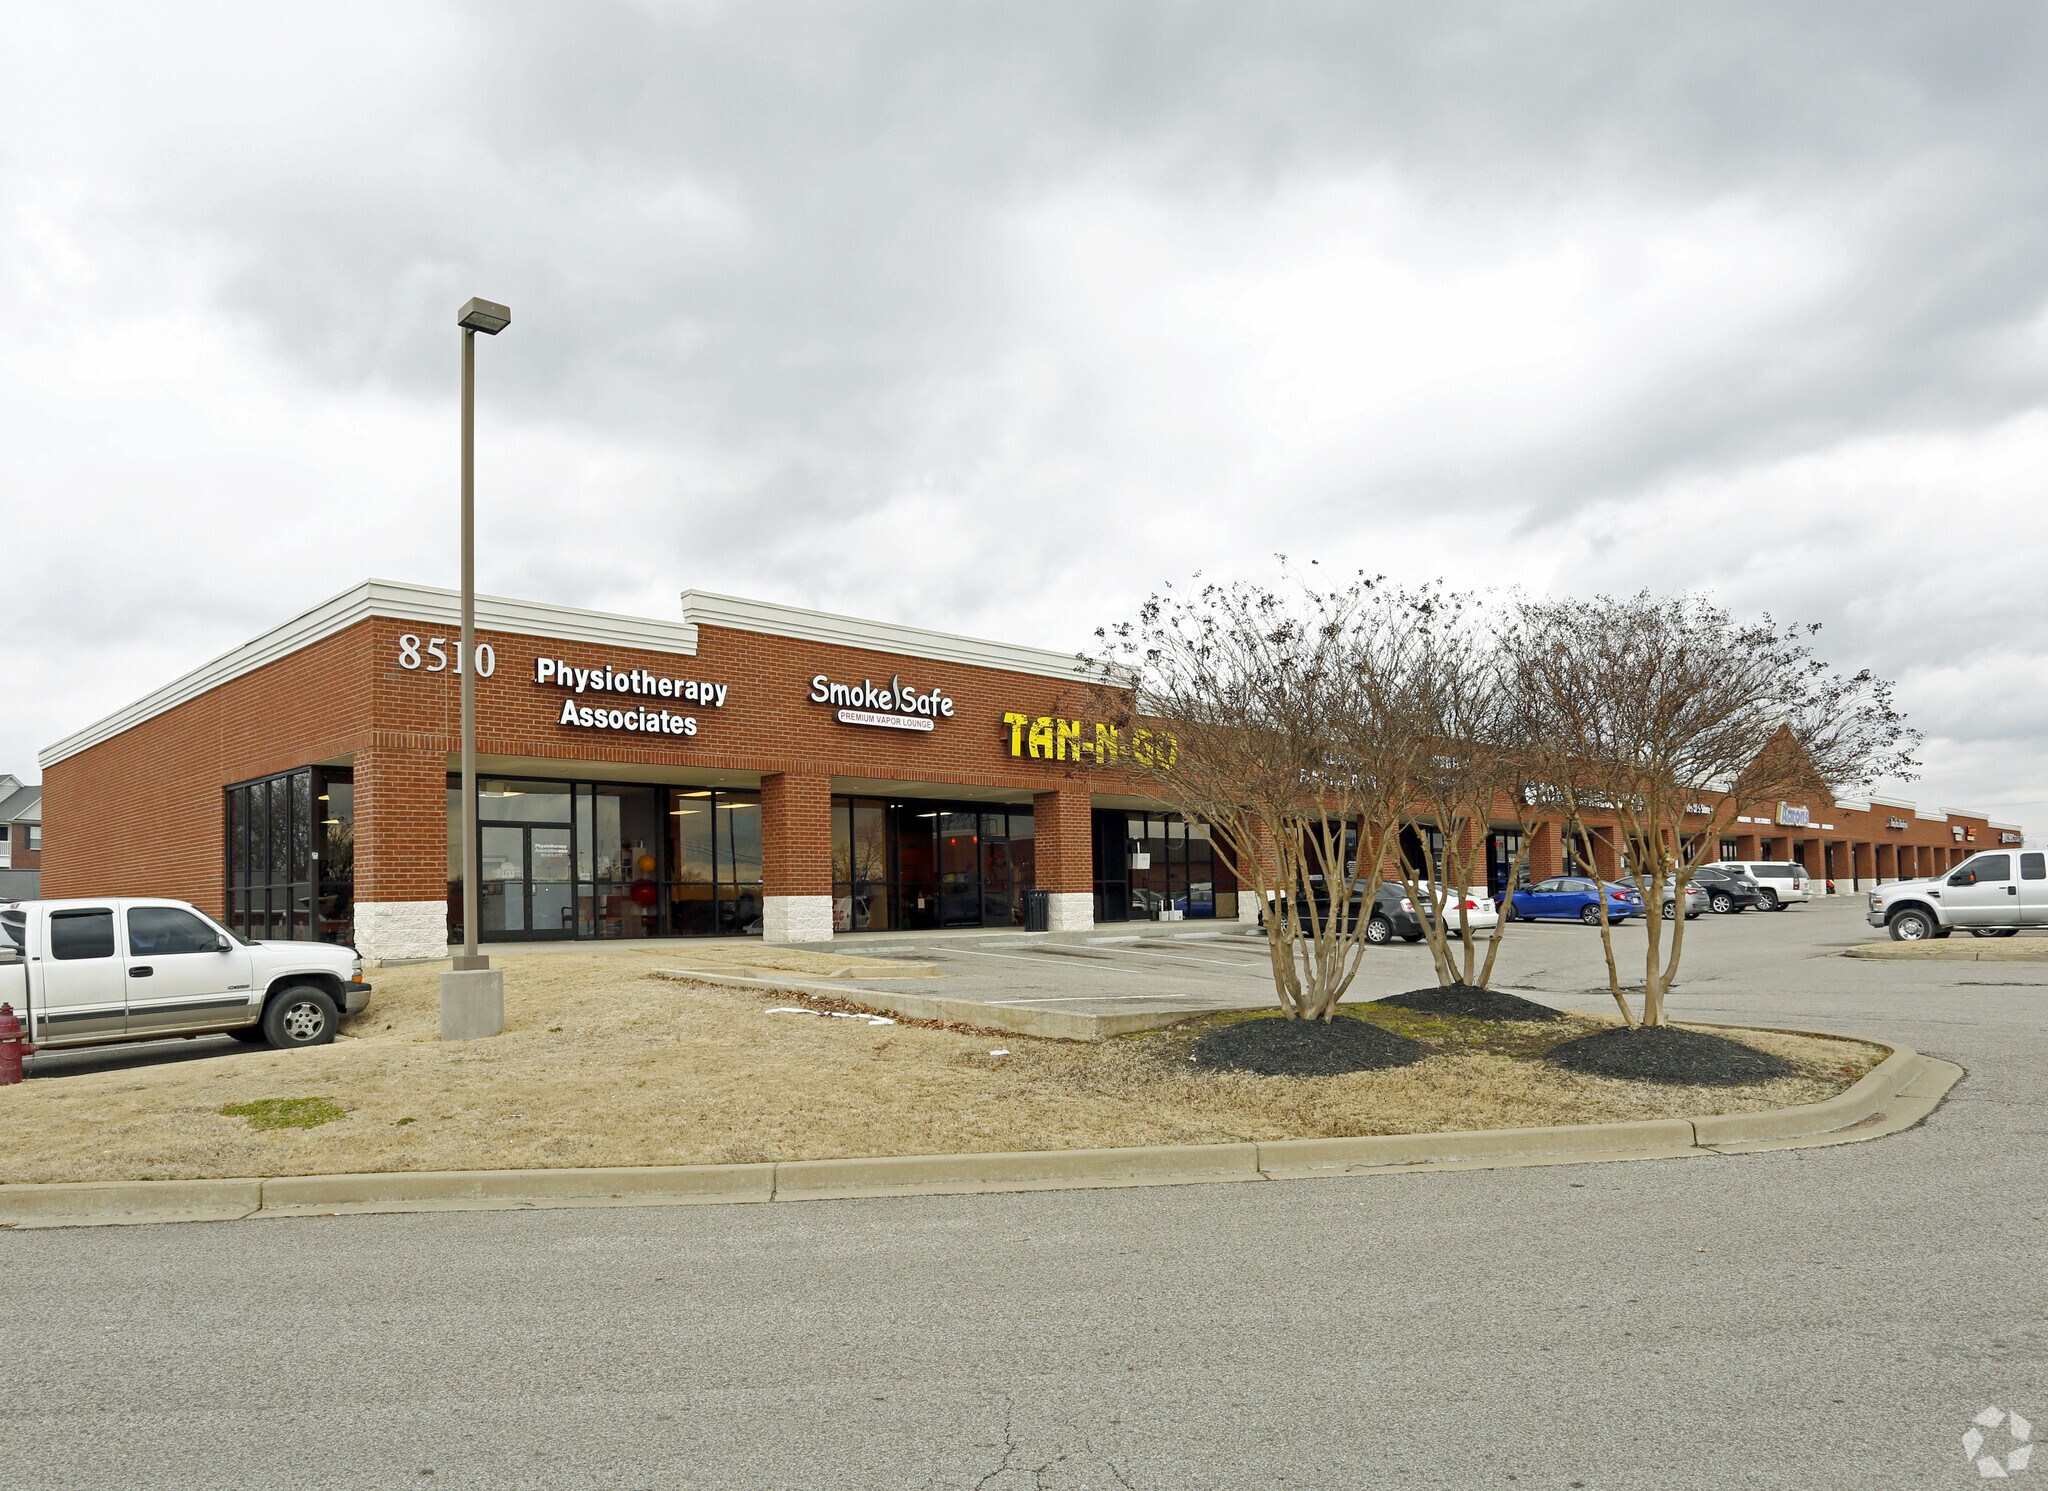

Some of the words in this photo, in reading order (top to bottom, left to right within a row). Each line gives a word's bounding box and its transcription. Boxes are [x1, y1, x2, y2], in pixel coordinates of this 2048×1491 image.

[399, 634, 495, 678] 8510
[537, 657, 728, 707] Physiotherapy
[811, 675, 893, 710] Smoke
[900, 686, 954, 717] Safe
[561, 700, 698, 736] Associates
[840, 711, 875, 723] PREMIUM
[876, 716, 901, 726] VAPOR
[902, 718, 932, 729] LOUNGE
